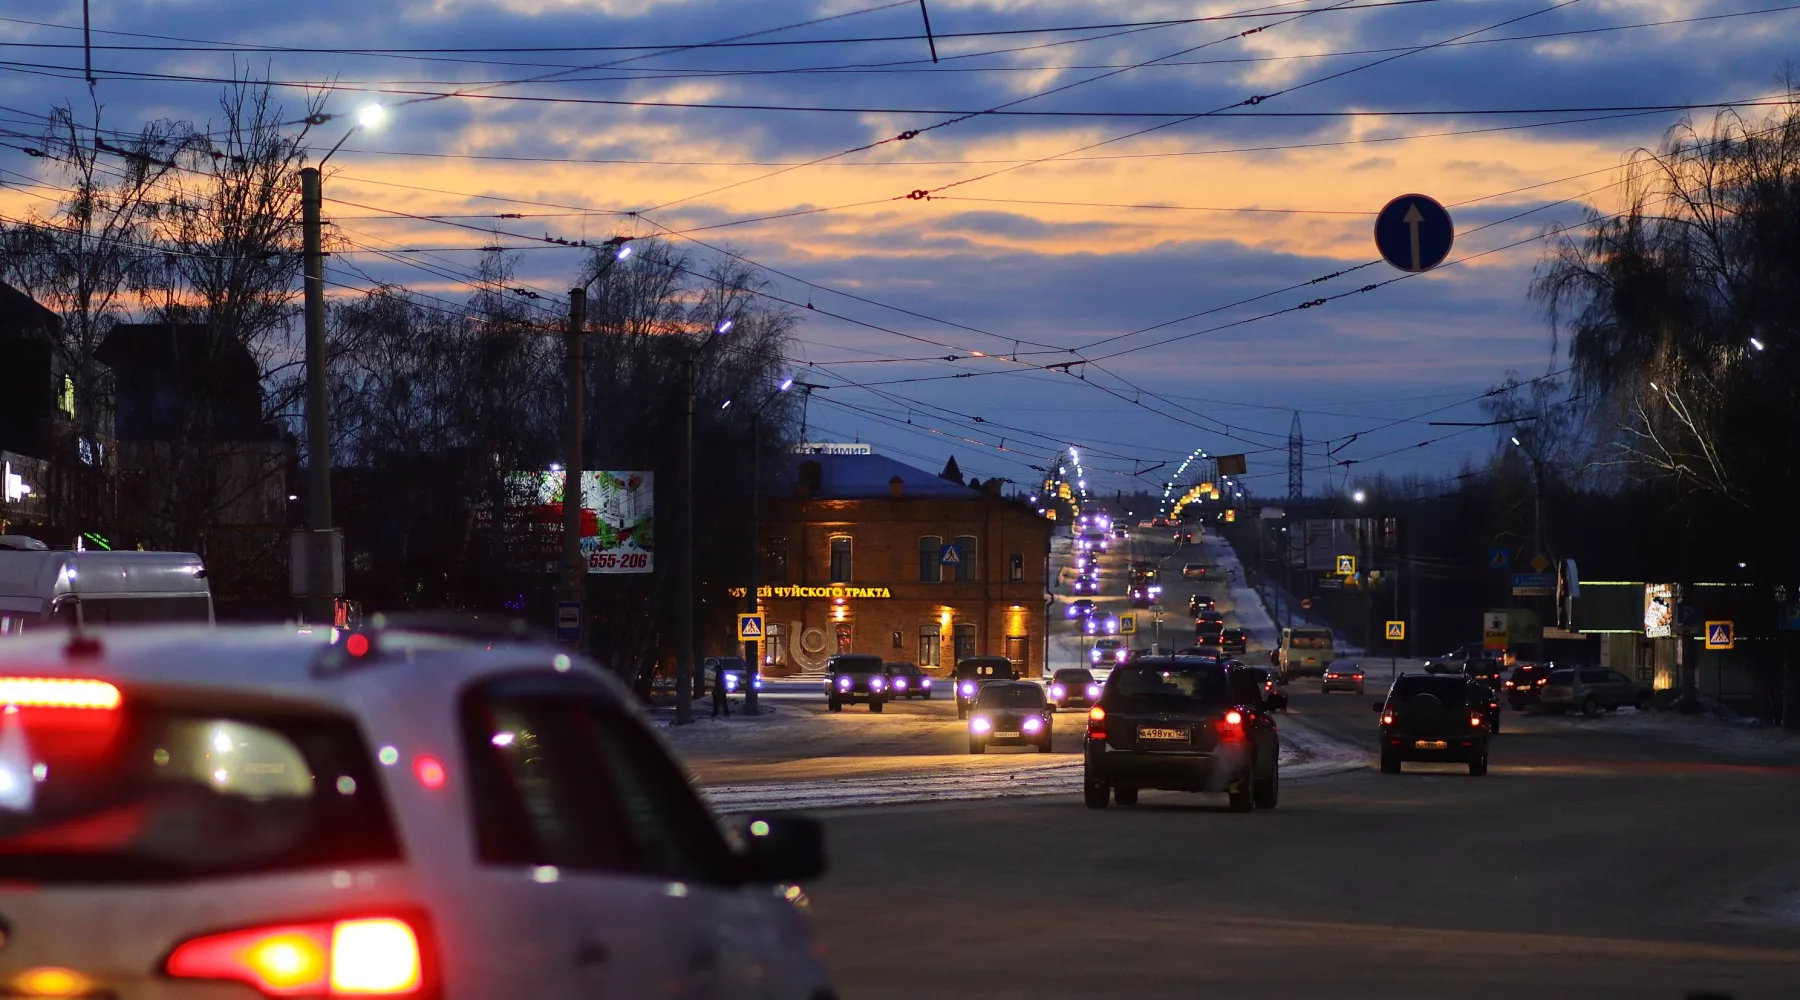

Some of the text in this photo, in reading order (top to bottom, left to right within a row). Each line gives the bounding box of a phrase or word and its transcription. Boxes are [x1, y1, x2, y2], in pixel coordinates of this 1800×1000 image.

[589, 553, 648, 568] 555-206
[728, 583, 891, 597] МУЕЙ ЧУЙСКОГО ТРАКТА
